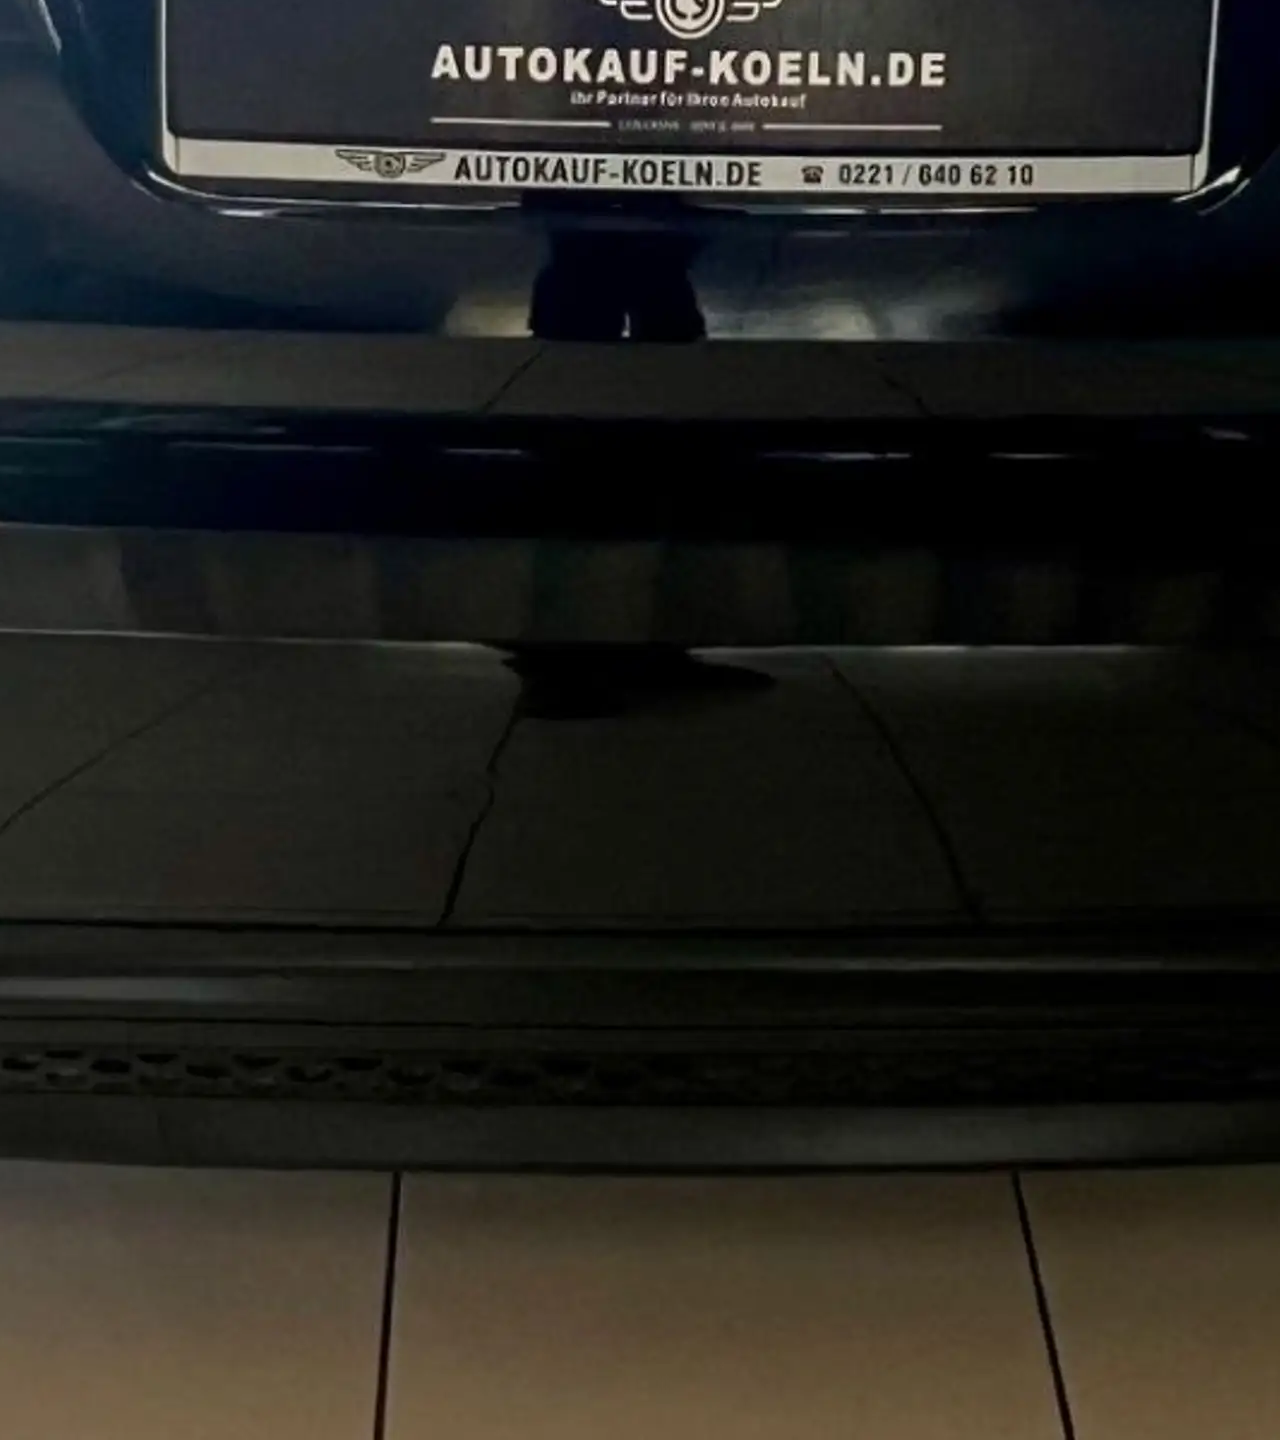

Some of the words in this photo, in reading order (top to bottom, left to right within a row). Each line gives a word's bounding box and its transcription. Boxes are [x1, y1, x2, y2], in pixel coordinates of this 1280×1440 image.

[431, 44, 946, 86] AUTOKAUF-KOELN.DE
[454, 156, 762, 187] AUTOKAUF-KOELN.DE
[838, 164, 893, 185] 0221
[919, 164, 961, 186] 640
[970, 164, 997, 186] 62
[1008, 164, 1034, 186] 10
